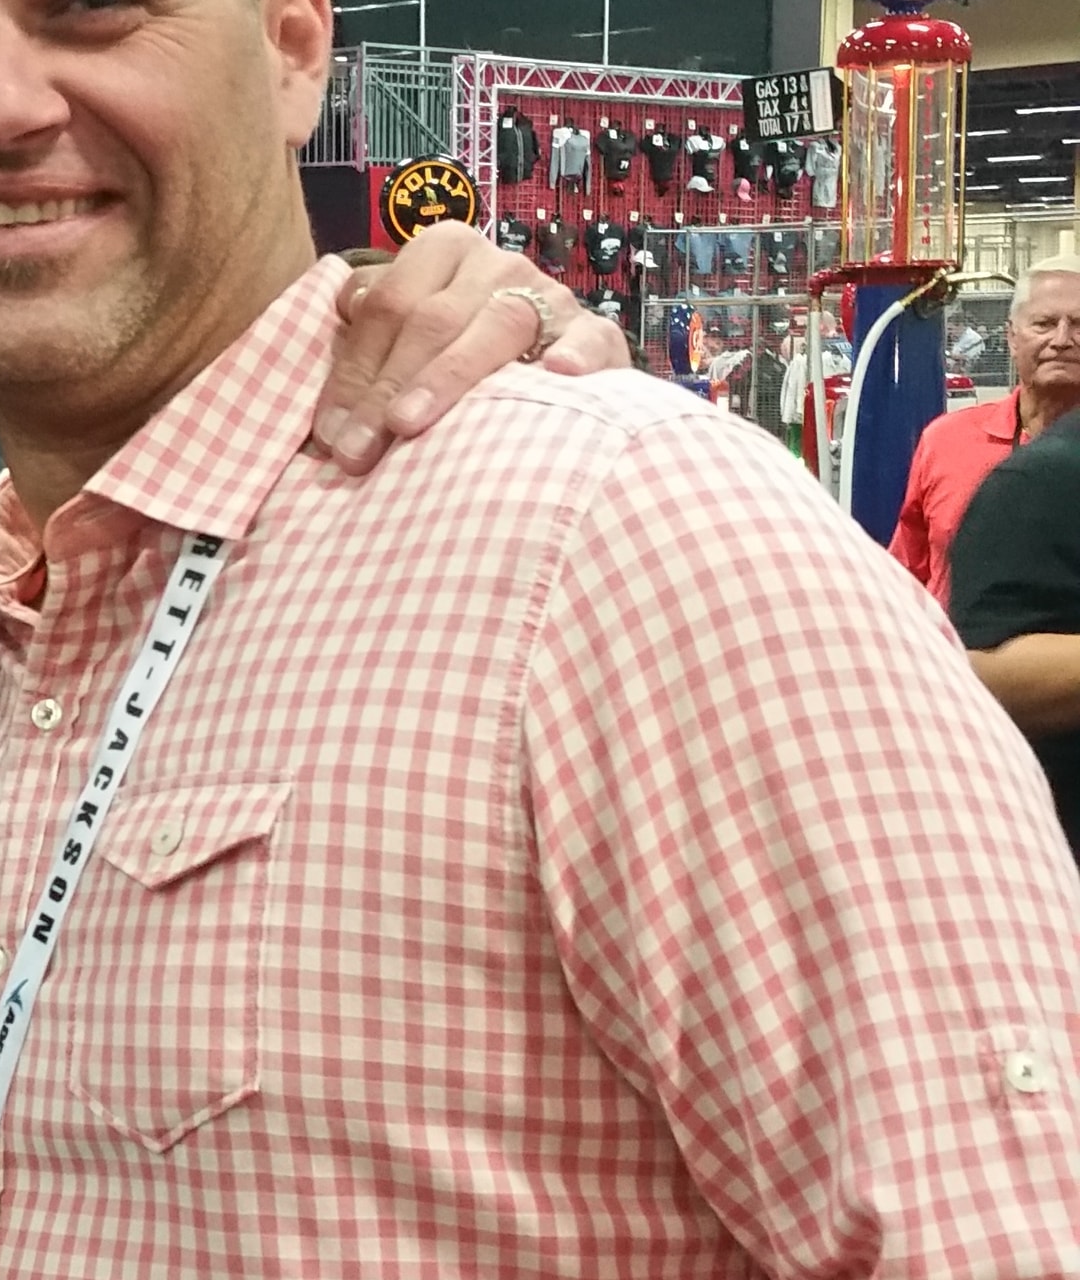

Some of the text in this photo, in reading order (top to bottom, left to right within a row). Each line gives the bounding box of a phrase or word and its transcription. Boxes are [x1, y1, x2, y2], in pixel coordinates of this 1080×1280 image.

[755, 77, 779, 99] GAS
[782, 76, 797, 94] 13
[757, 98, 780, 118] TAX
[758, 118, 783, 137] TOTAL
[785, 114, 800, 133] 17
[395, 167, 469, 207] POLLY
